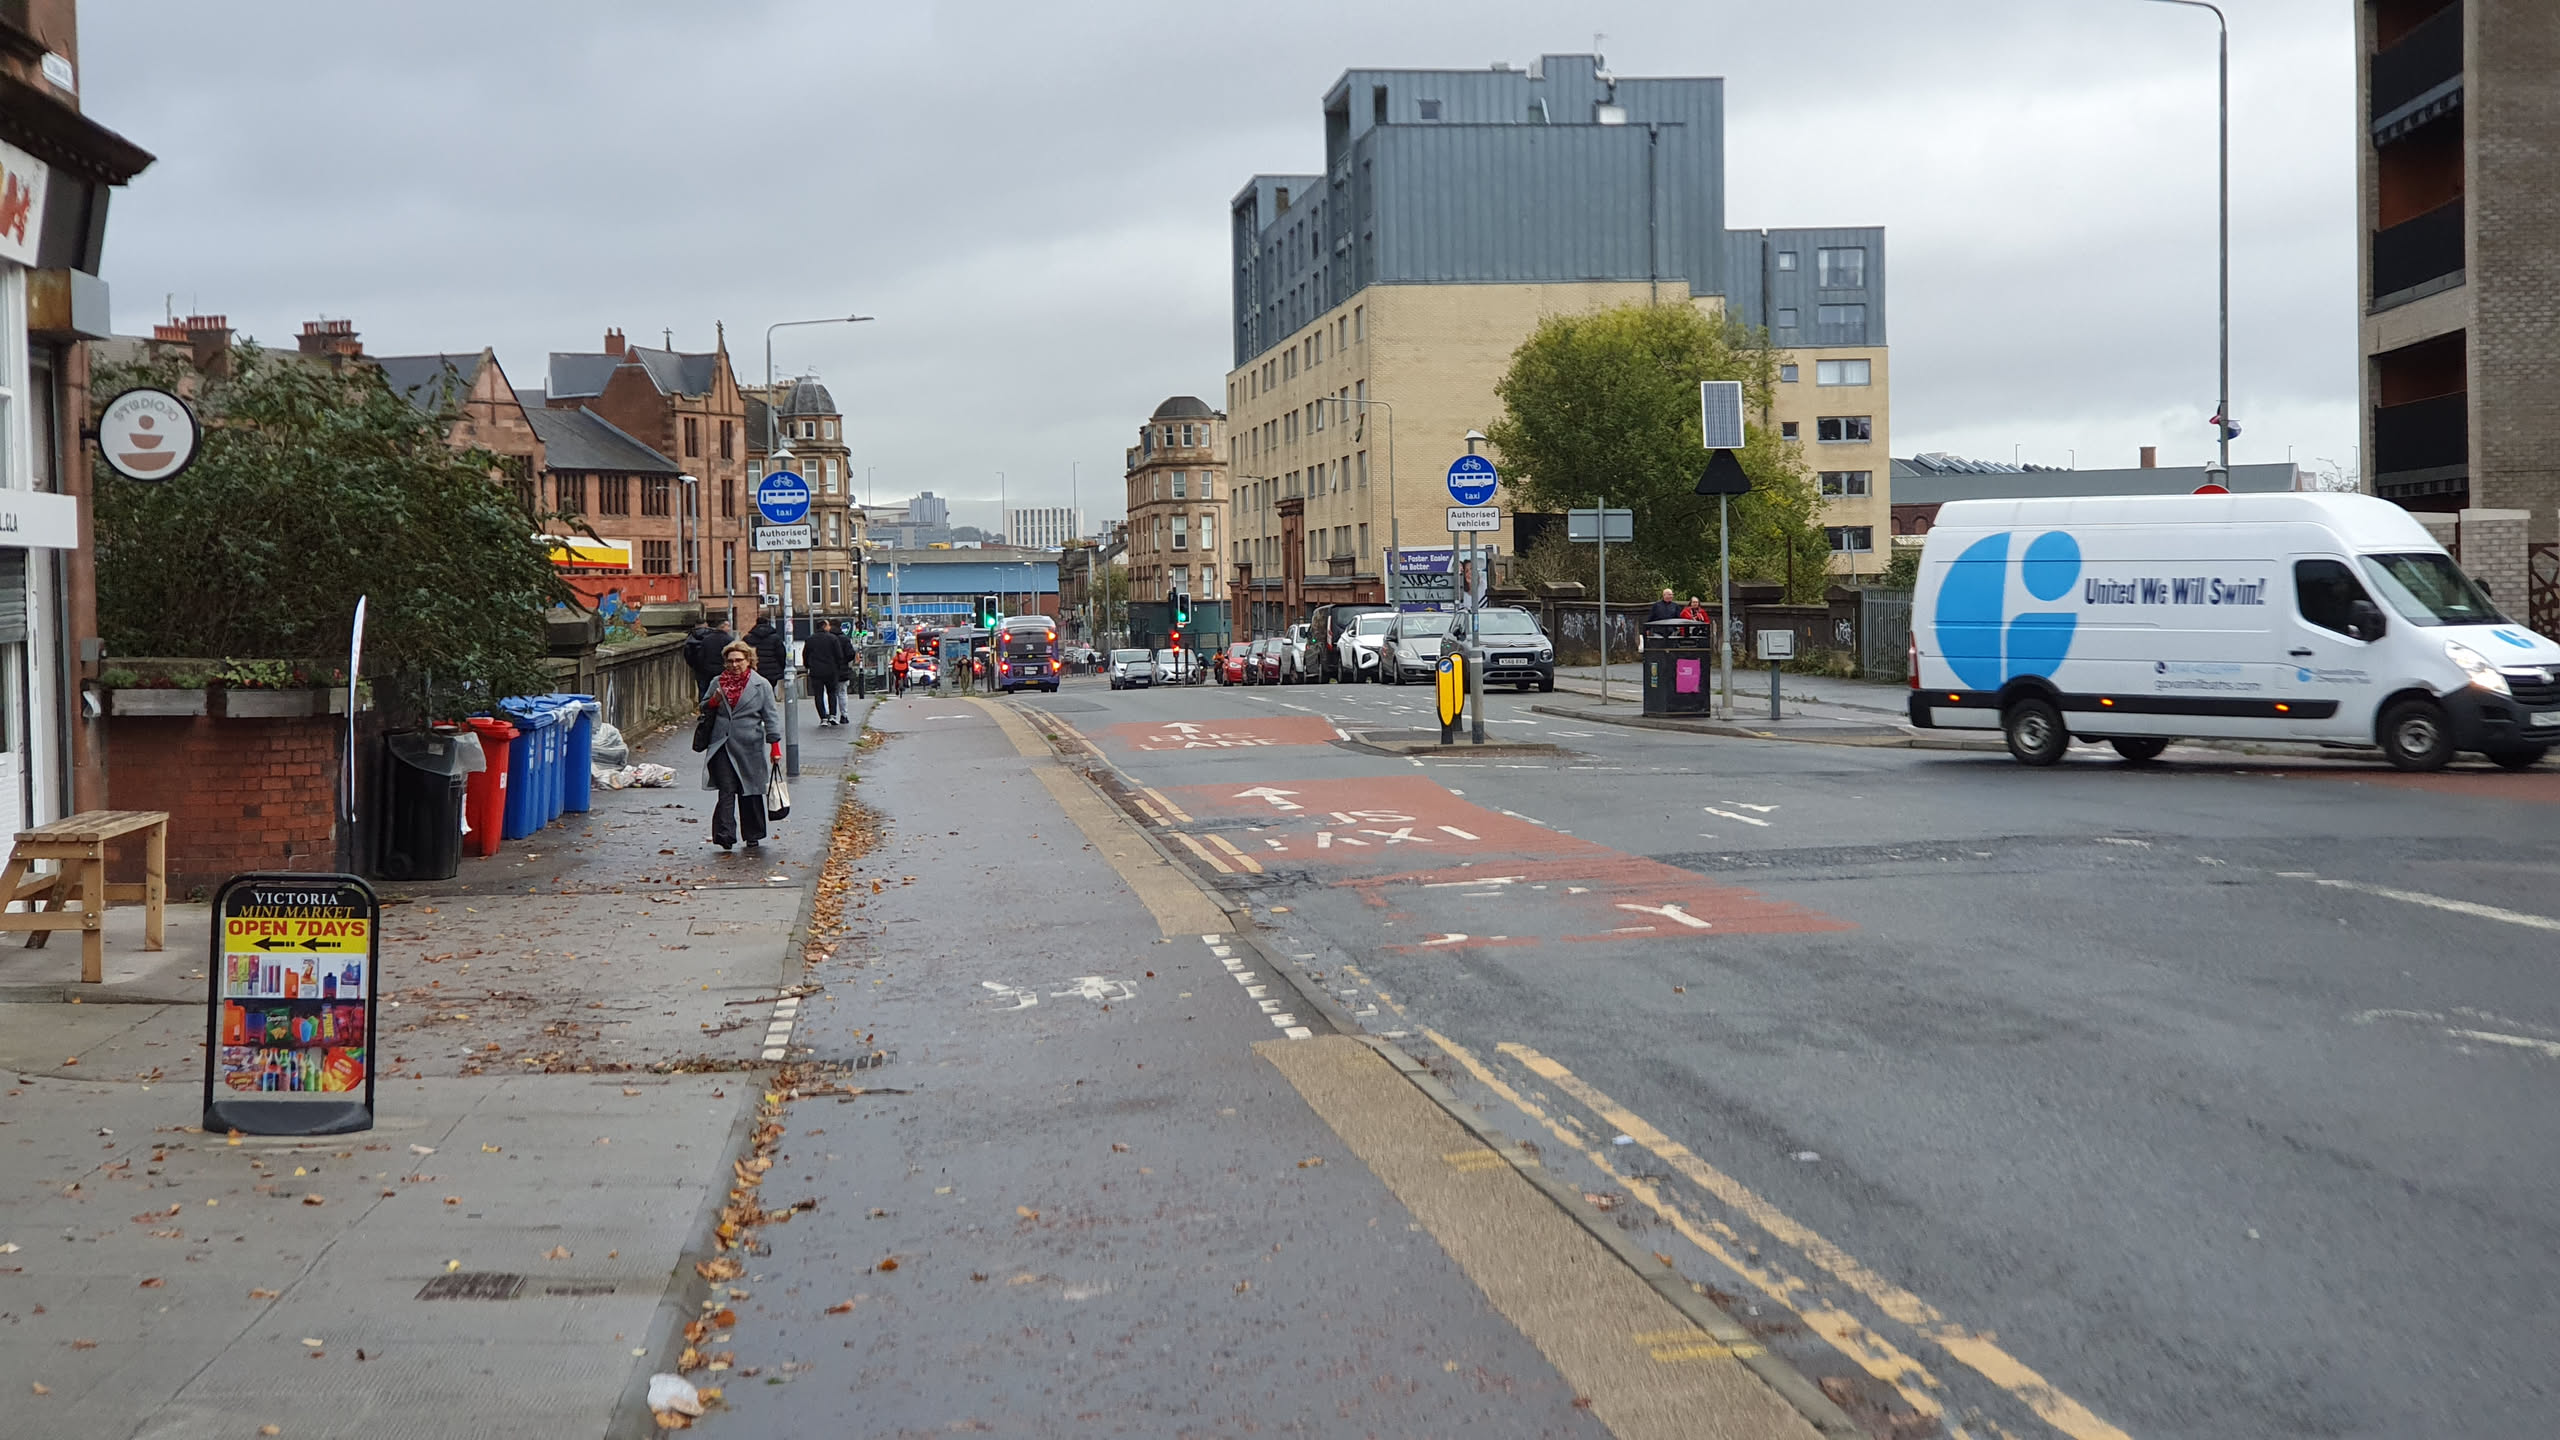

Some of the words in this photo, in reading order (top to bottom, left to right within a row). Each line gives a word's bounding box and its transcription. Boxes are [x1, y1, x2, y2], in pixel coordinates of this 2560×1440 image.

[1464, 491, 1480, 500] taxi
[776, 508, 792, 516] taxi
[1450, 511, 1496, 519] Authorised
[760, 528, 807, 537] Authorised
[2084, 577, 2136, 605] United
[2139, 577, 2168, 605] We
[2172, 577, 2206, 605] Will
[2210, 577, 2267, 606] Swim!
[1148, 732, 1257, 742] BUS
[1139, 739, 1280, 751] LANE
[254, 892, 339, 905] VICTORIA
[238, 905, 280, 918] MINI
[283, 905, 355, 919] MARKET
[228, 920, 288, 936] OPEN
[296, 920, 366, 937] 7DAYS
